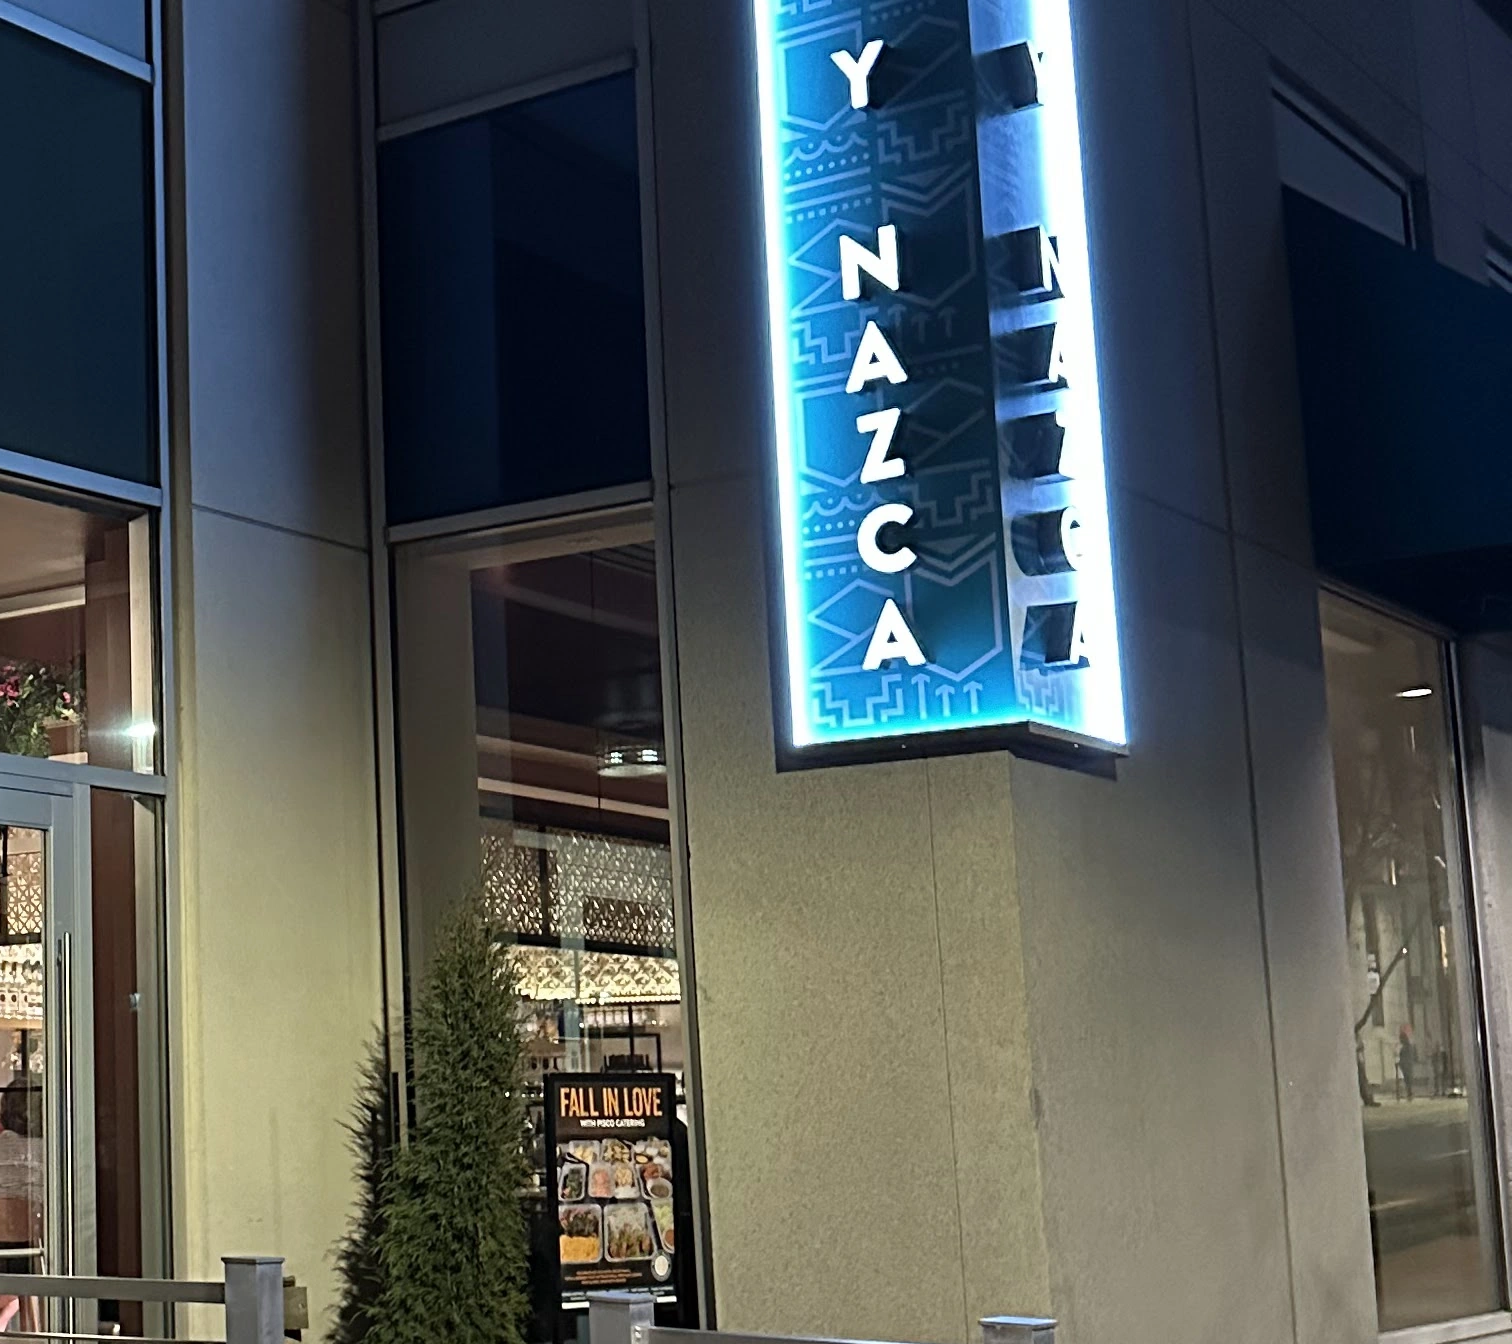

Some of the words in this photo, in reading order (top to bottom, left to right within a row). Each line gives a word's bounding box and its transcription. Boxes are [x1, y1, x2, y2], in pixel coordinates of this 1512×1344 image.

[830, 39, 884, 110] Y
[839, 223, 928, 671] NAZCA
[560, 1087, 599, 1117] FALL
[603, 1087, 620, 1117] IN
[624, 1086, 663, 1117] LOVE
[597, 1119, 615, 1128] PISCO
